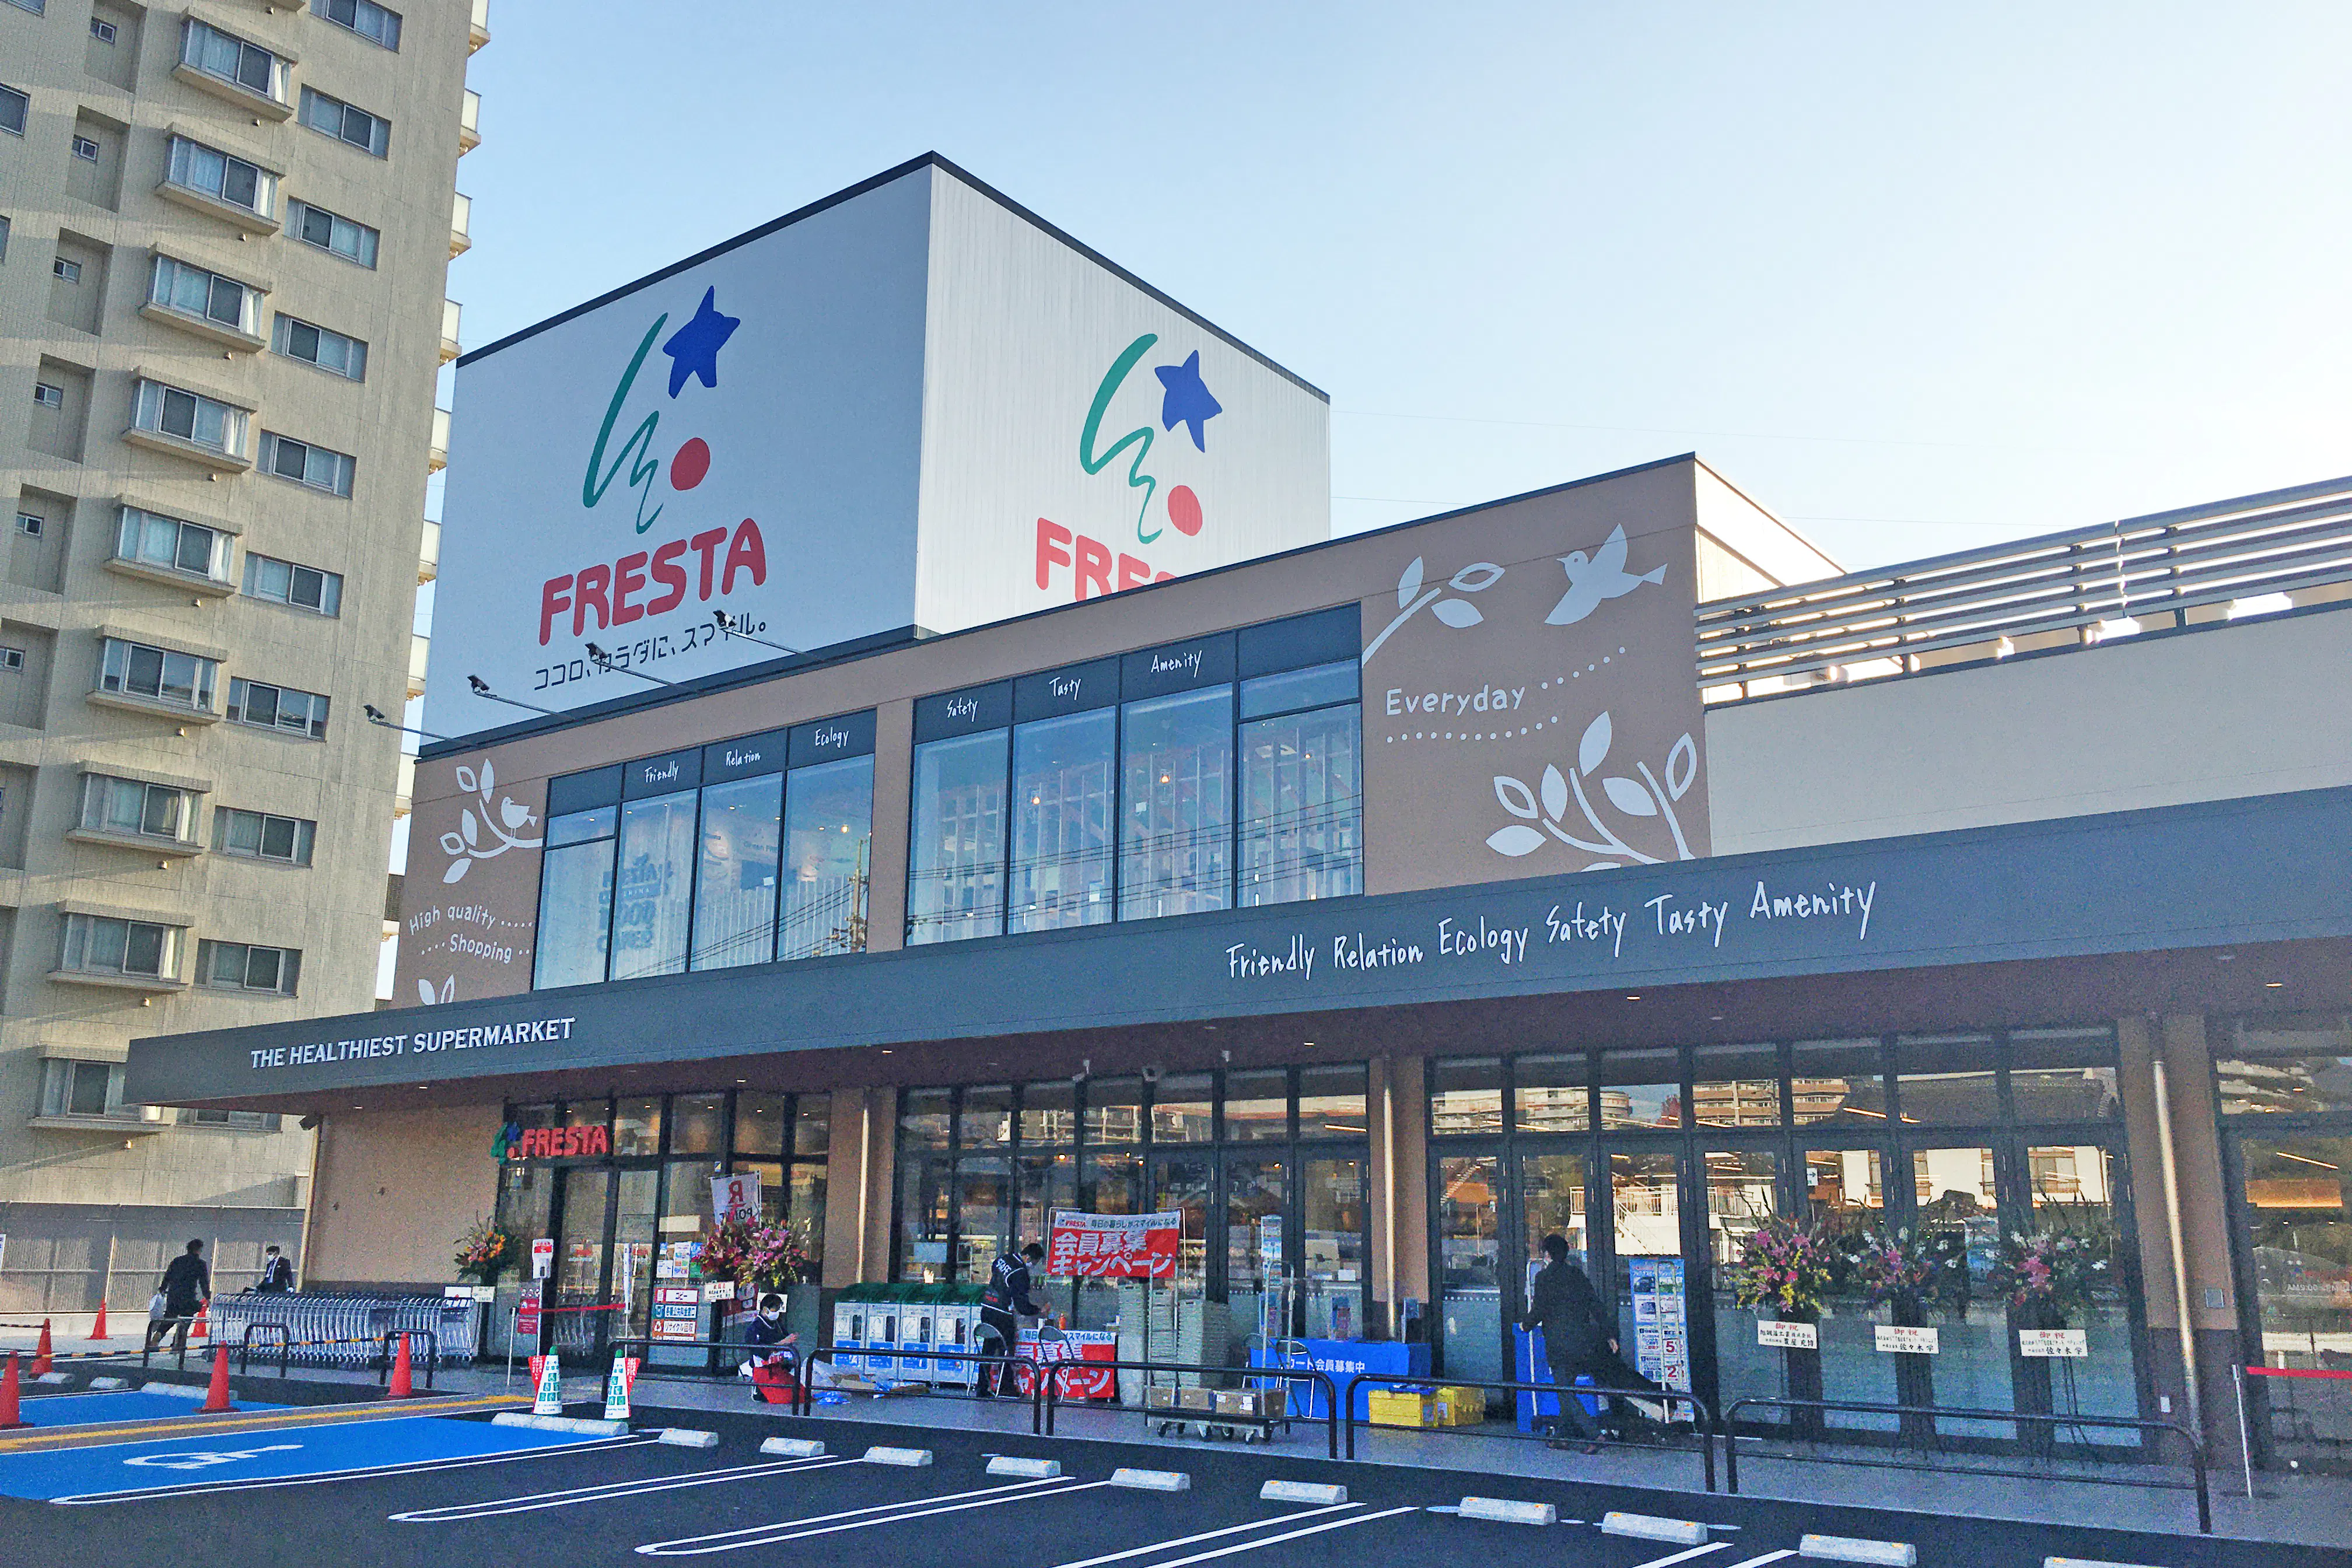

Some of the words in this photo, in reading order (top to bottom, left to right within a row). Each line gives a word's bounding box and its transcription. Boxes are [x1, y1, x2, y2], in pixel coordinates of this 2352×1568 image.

[1036, 517, 1179, 603] FRE
[539, 518, 767, 646] FRESTA
[1151, 650, 1202, 678] Amenity
[1049, 677, 1082, 701] Tasty
[1386, 684, 1525, 716] Everyday
[815, 729, 849, 748] Ecology
[726, 749, 761, 767] Relation
[645, 761, 679, 784] Friendly
[410, 905, 440, 936] High
[447, 904, 496, 930] quality
[1226, 933, 1315, 981] Friendly
[1334, 932, 1423, 971] Relation
[1438, 915, 1528, 964] Ecology
[1644, 894, 1728, 947] Tasty
[1749, 881, 1876, 940] Amenity
[450, 933, 512, 964] Shopping
[251, 1047, 285, 1069] THE
[289, 1034, 408, 1066] HEALTHIEST
[413, 1017, 576, 1054] SUPERMARKET
[522, 1125, 608, 1157] FRESTA
[1055, 1230, 1147, 1256] 会員募集
[996, 1258, 1012, 1275] STAFF
[1051, 1252, 1172, 1276] キャンペーン
[675, 1291, 688, 1300] コピー
[665, 1323, 694, 1332] リサイクル回収
